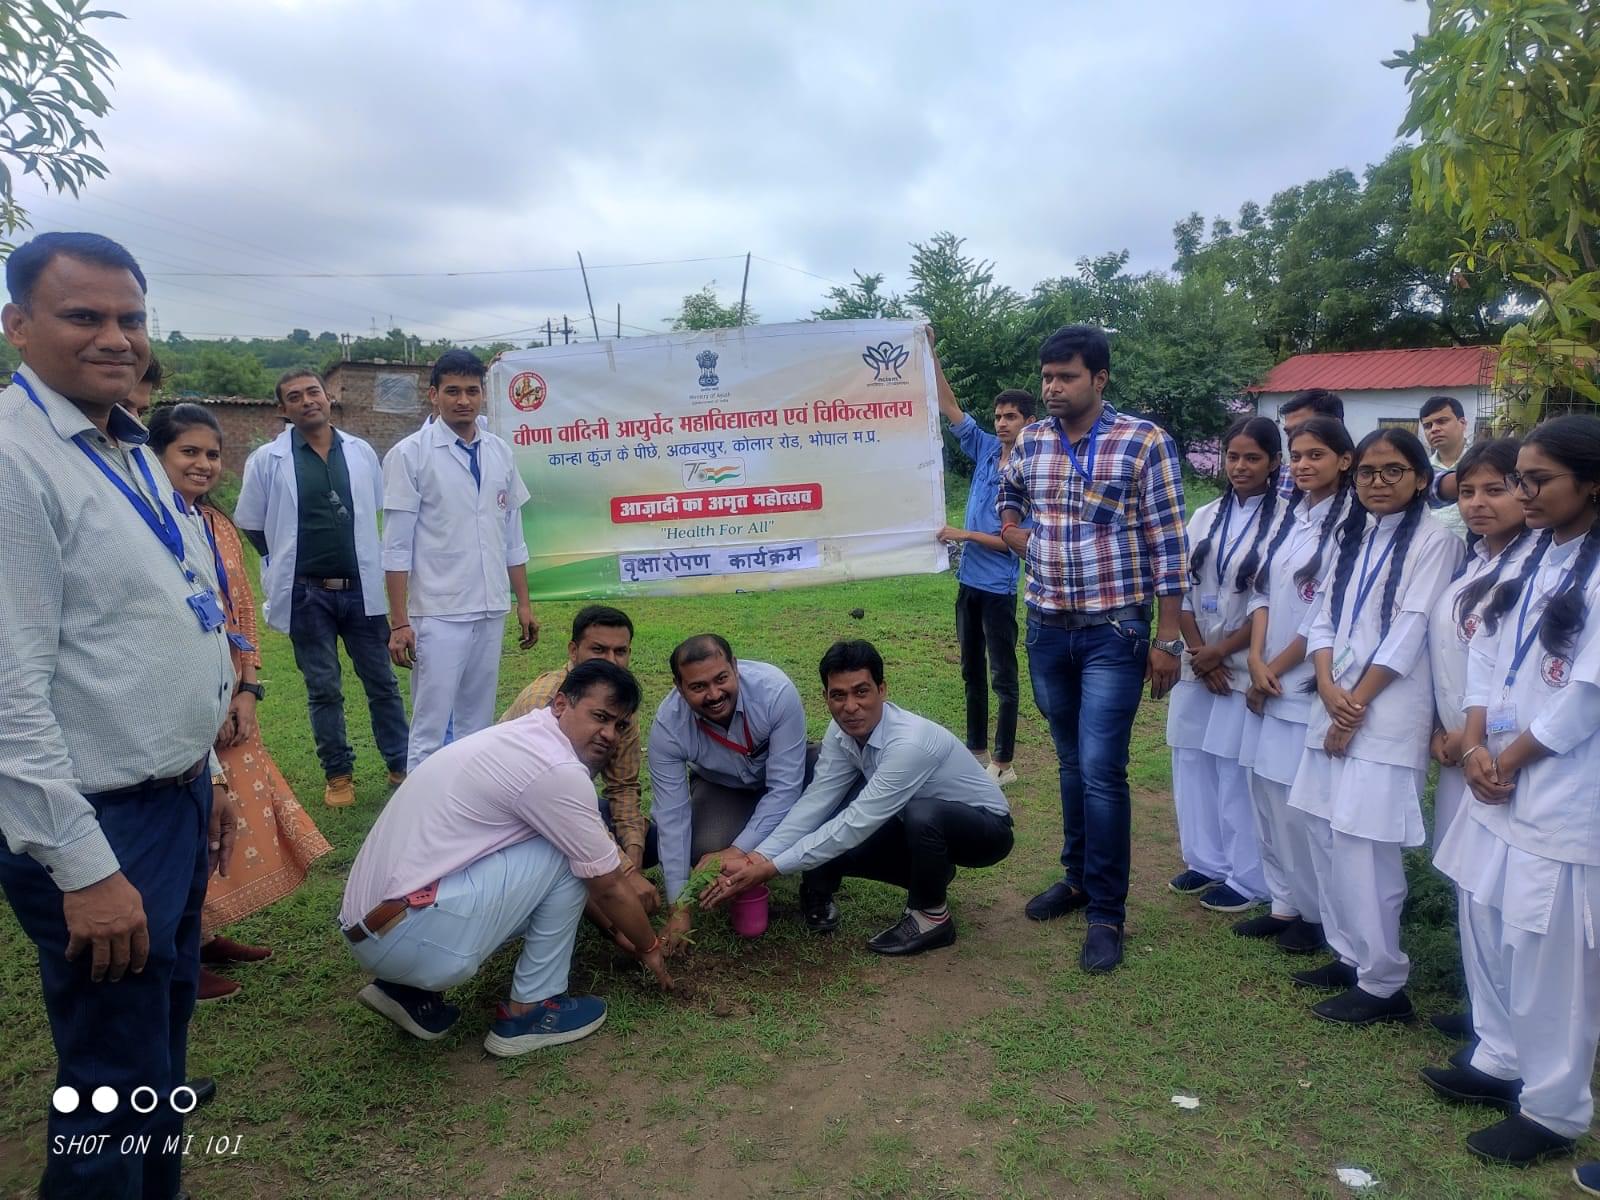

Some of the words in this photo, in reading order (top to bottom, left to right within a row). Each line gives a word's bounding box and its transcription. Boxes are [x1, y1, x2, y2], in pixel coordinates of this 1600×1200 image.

[512, 424, 552, 446] वीणा
[557, 417, 609, 442] वादिनी
[615, 413, 673, 441] आयुर्वेद
[678, 407, 777, 432] महाविद्यालय
[783, 402, 808, 425] एवं
[813, 399, 913, 424] चिकित्सालय
[548, 452, 582, 467] कान्हा
[587, 447, 611, 467] कुंज
[617, 445, 629, 461] के
[633, 442, 661, 460] पीछे,
[666, 440, 727, 458] अकबरपुर,
[732, 435, 774, 453] कोलार
[779, 433, 803, 450] रोड,
[808, 430, 848, 447] भोपाल
[619, 496, 679, 518] आज़ादी
[682, 497, 703, 512] का
[708, 494, 749, 514] अमृत
[752, 488, 813, 507] महोत्सव
[661, 523, 715, 540] "Health
[720, 522, 743, 537] For
[747, 520, 775, 535] All"
[622, 551, 711, 581] वृक्षारोपण
[728, 545, 802, 569] कार्यक्रम
